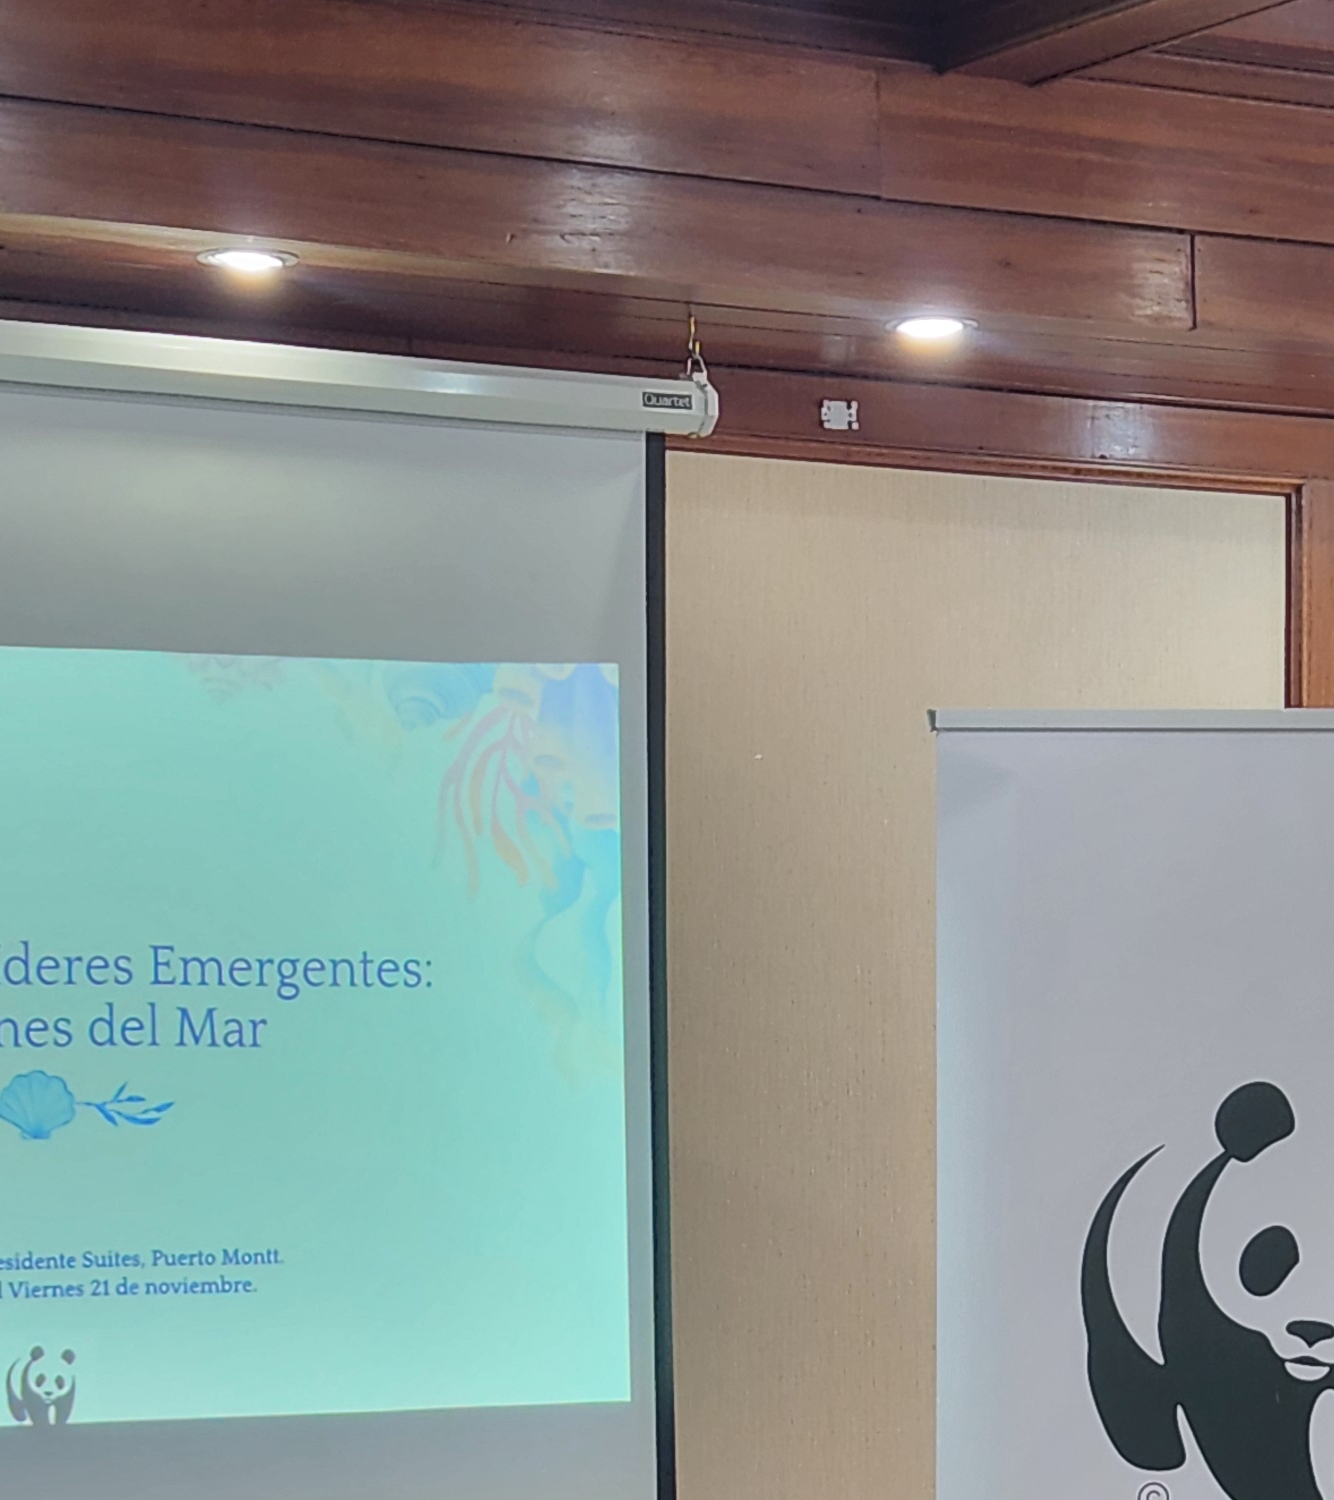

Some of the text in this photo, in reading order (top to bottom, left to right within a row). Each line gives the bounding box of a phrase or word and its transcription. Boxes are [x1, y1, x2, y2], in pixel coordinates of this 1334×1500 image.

[644, 393, 690, 407] Quartet
[148, 944, 433, 1001] Emergentes:
[88, 1002, 160, 1047] del
[175, 1006, 268, 1047] Mar
[82, 1250, 146, 1269] Suites,
[151, 1248, 216, 1268] Puerto
[8, 1278, 85, 1298] Viernes
[90, 1278, 110, 1296] 21
[115, 1276, 139, 1295] de
[144, 1275, 258, 1295] noviembre.
